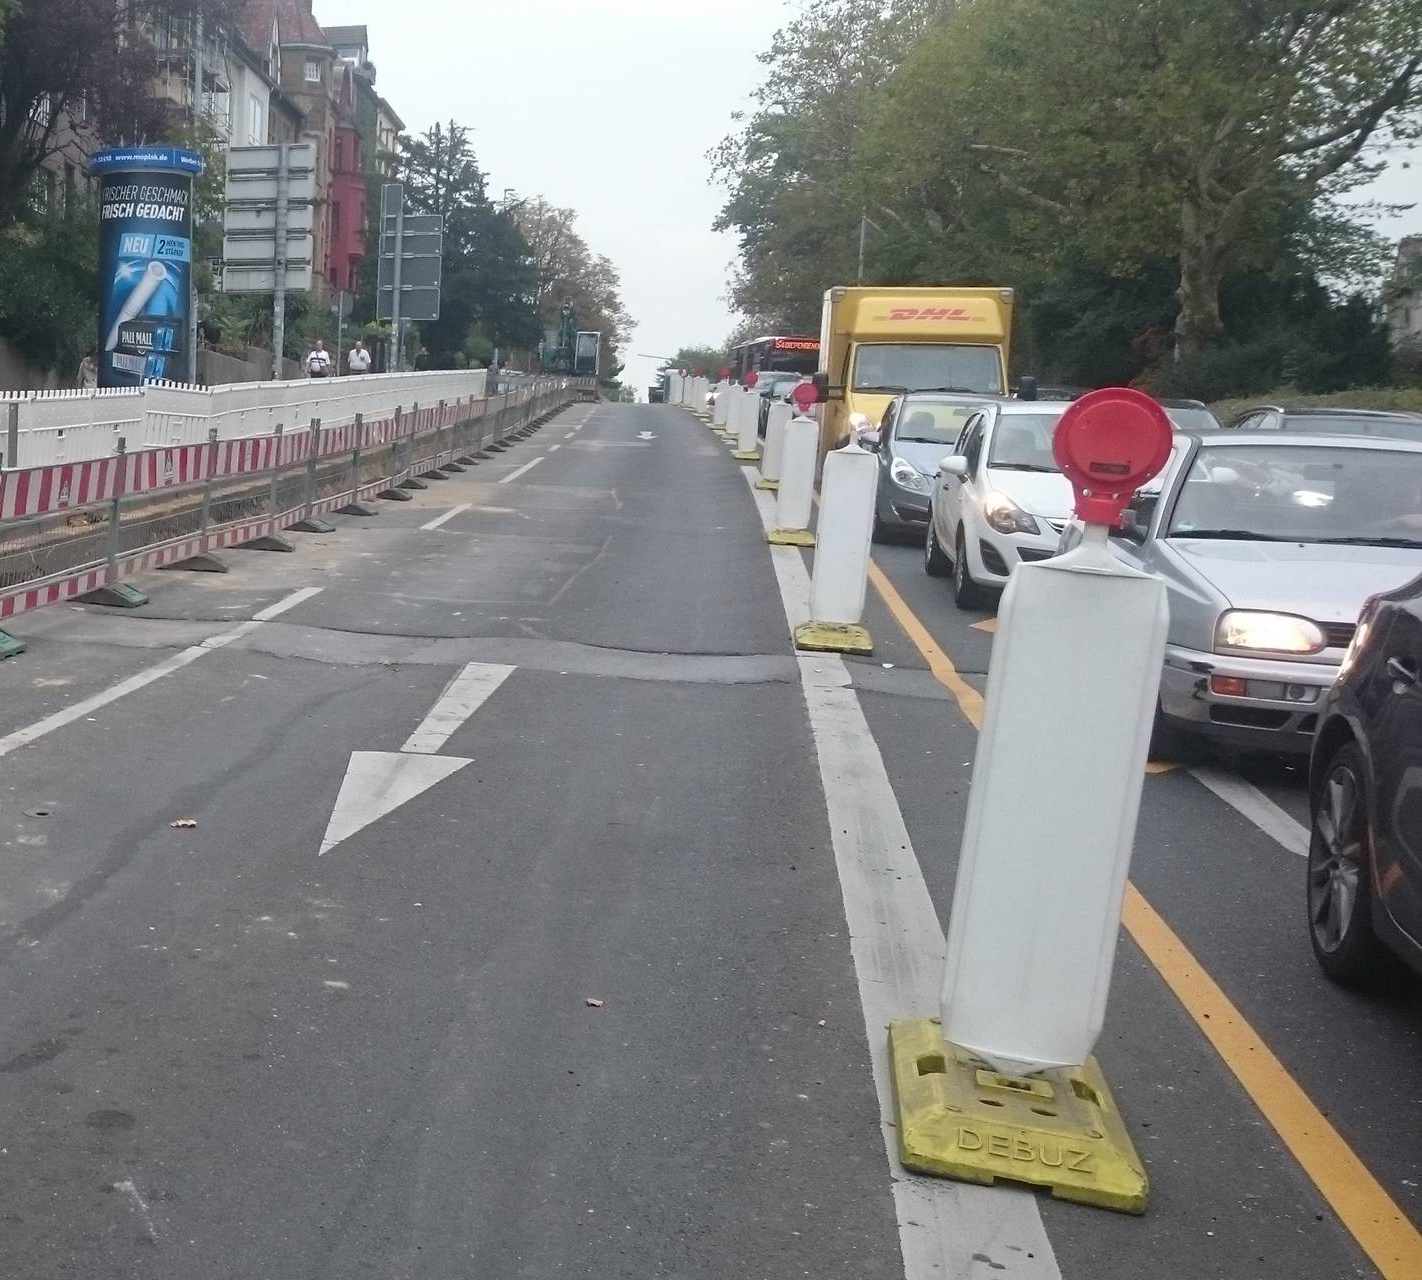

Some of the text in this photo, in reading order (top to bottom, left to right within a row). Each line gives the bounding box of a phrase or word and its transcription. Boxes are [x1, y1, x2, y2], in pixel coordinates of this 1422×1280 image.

[139, 185, 189, 205] GESCHMACK
[101, 202, 185, 222] FRISCH GEDACHT
[124, 236, 149, 253] NEU
[157, 239, 166, 255] 2
[889, 308, 971, 321] DHL
[121, 330, 153, 345] PALL MALL
[957, 1127, 1095, 1175] DEBUZ
